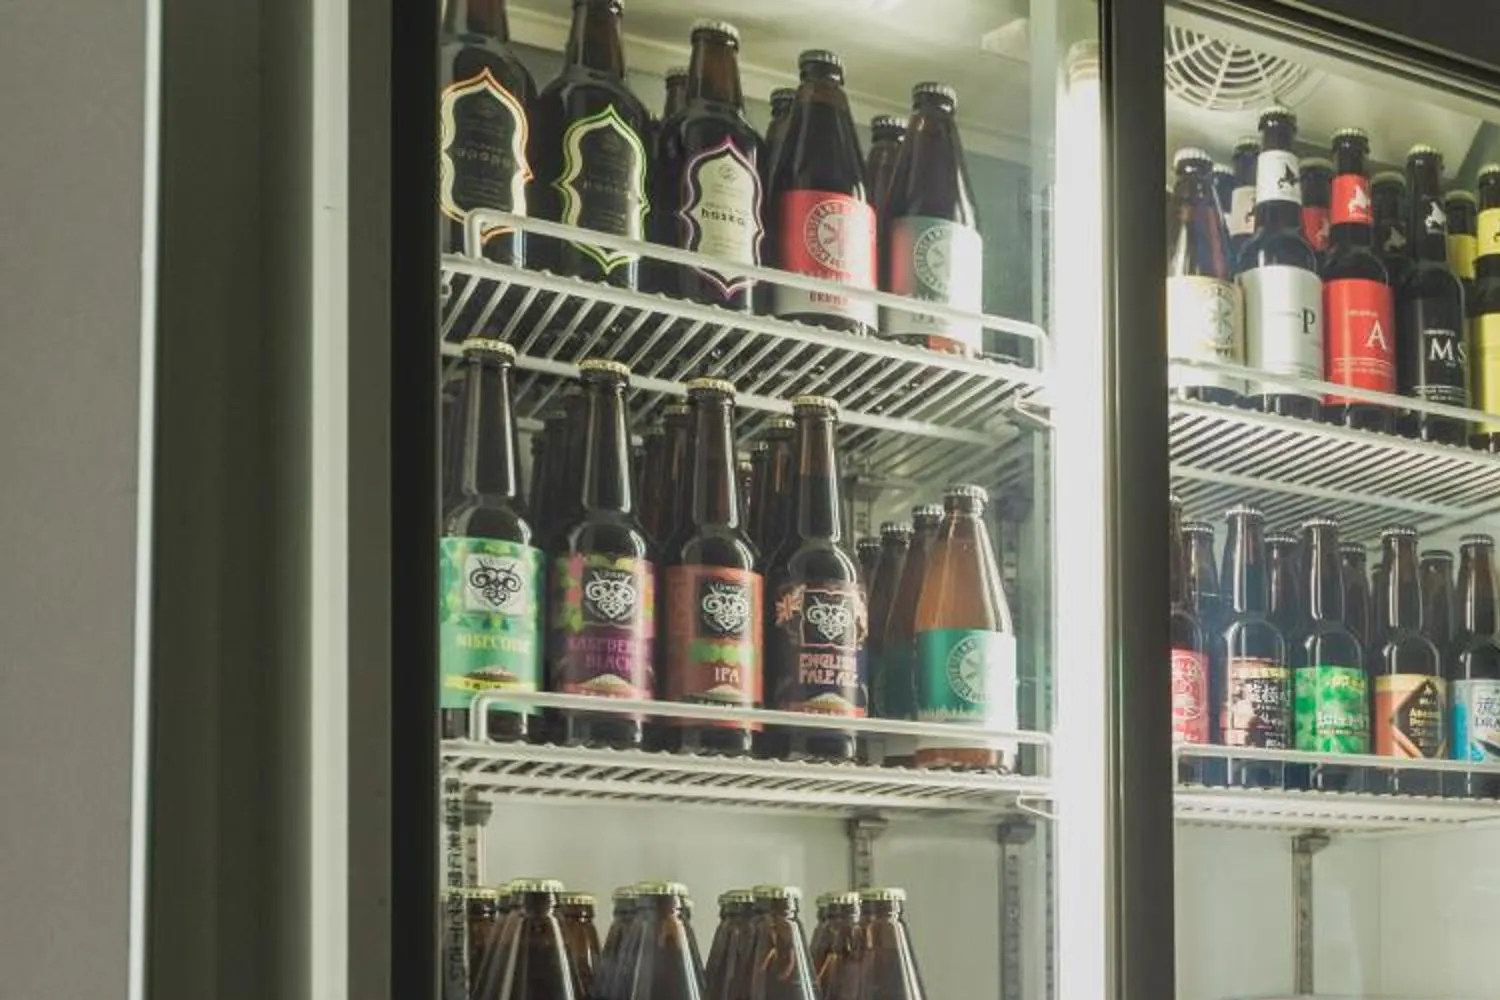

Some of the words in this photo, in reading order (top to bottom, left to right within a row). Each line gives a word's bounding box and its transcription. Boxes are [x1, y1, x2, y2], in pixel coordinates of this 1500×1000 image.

[1366, 319, 1388, 352] A
[799, 652, 857, 672] ENGLI
[714, 666, 740, 684] IPA
[799, 668, 836, 685] PALE
